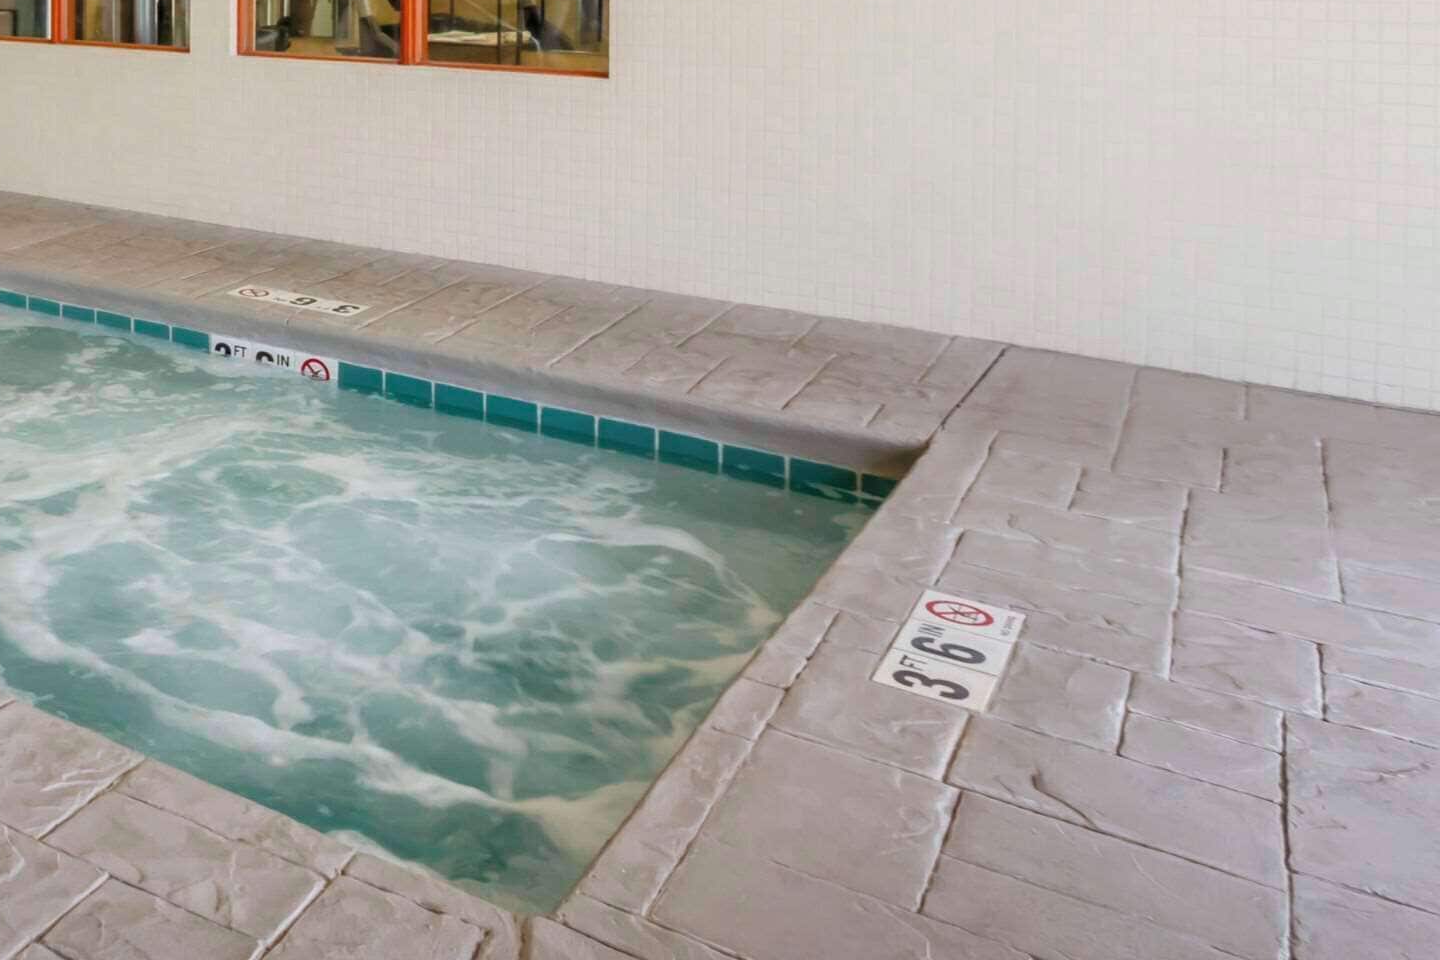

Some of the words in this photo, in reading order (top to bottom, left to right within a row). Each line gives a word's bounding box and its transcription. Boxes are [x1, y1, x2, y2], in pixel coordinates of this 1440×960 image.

[289, 297, 318, 306] 6
[332, 304, 360, 314] 3
[234, 345, 247, 357] FT
[277, 354, 290, 367] IN
[917, 623, 946, 639] IN
[910, 636, 987, 665] 6
[899, 654, 929, 672] FT
[892, 669, 970, 701] 3
